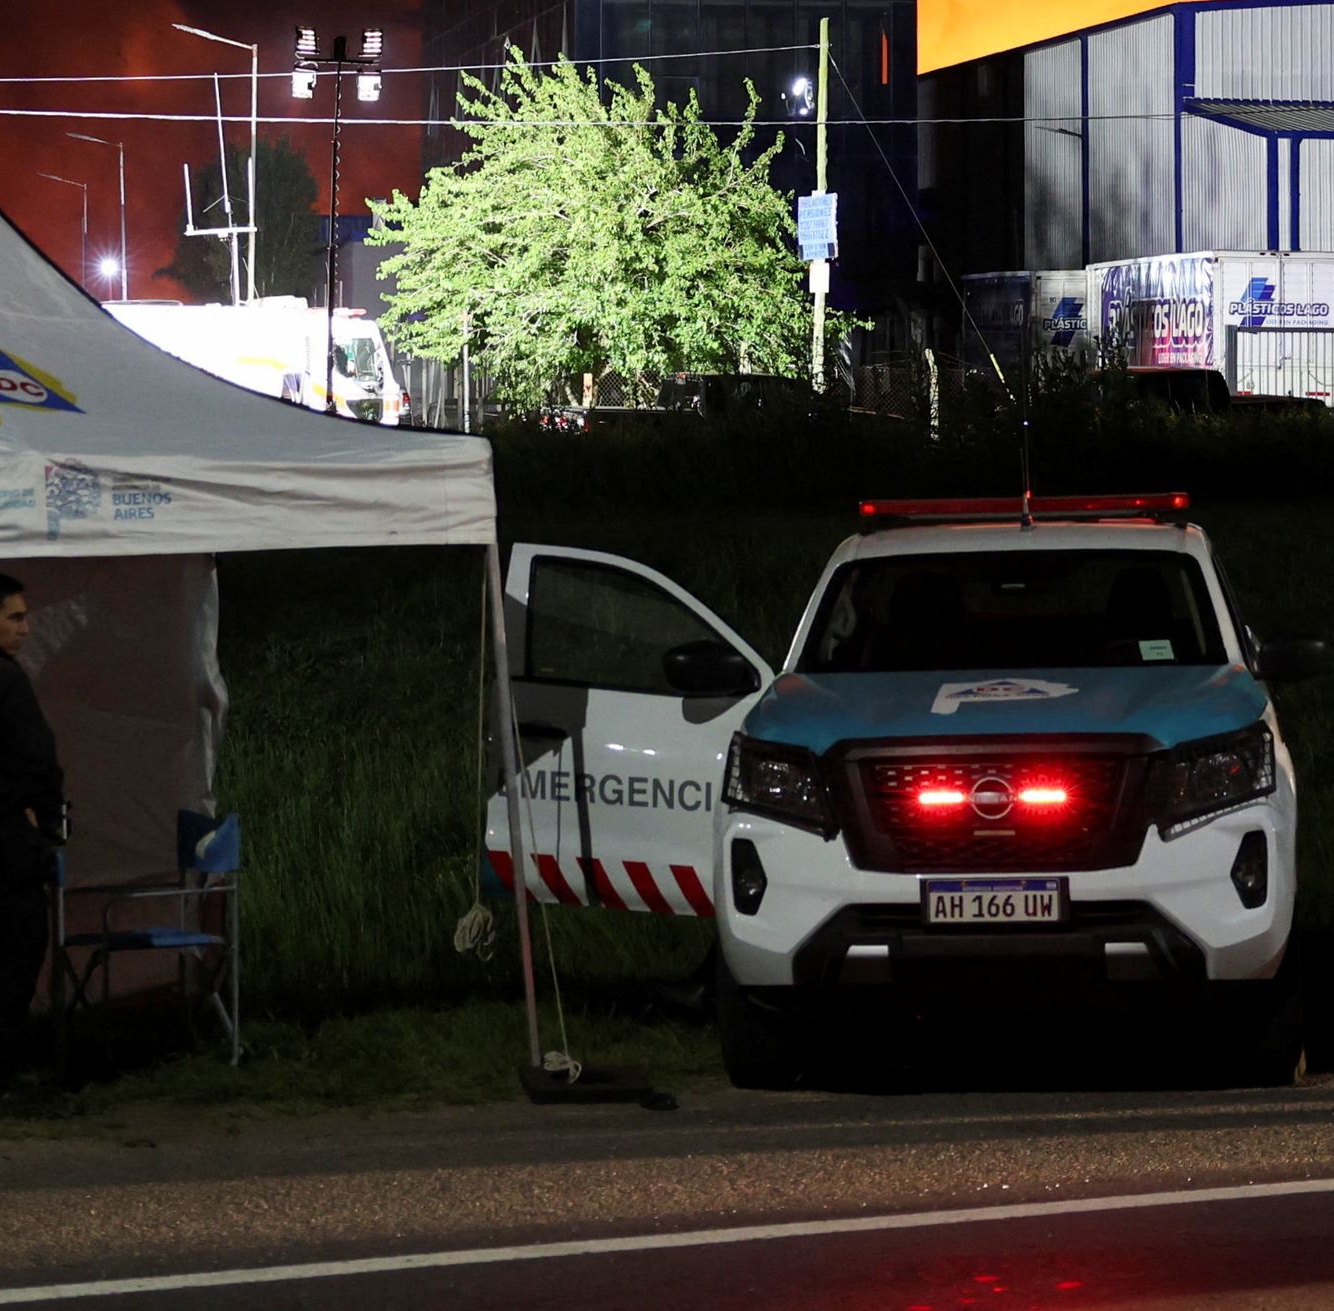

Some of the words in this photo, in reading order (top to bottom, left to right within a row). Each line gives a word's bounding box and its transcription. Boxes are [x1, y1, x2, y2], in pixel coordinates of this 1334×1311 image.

[1230, 297, 1294, 315] PLÁSTICOS
[1297, 304, 1328, 315] LAGO
[1172, 302, 1204, 338] LAGO
[113, 493, 171, 505] BUENOS
[114, 507, 154, 520] AIRES
[499, 769, 712, 812] MERGENCI
[935, 895, 964, 918] AH
[971, 894, 1015, 917] 166
[1024, 894, 1053, 917] UW
